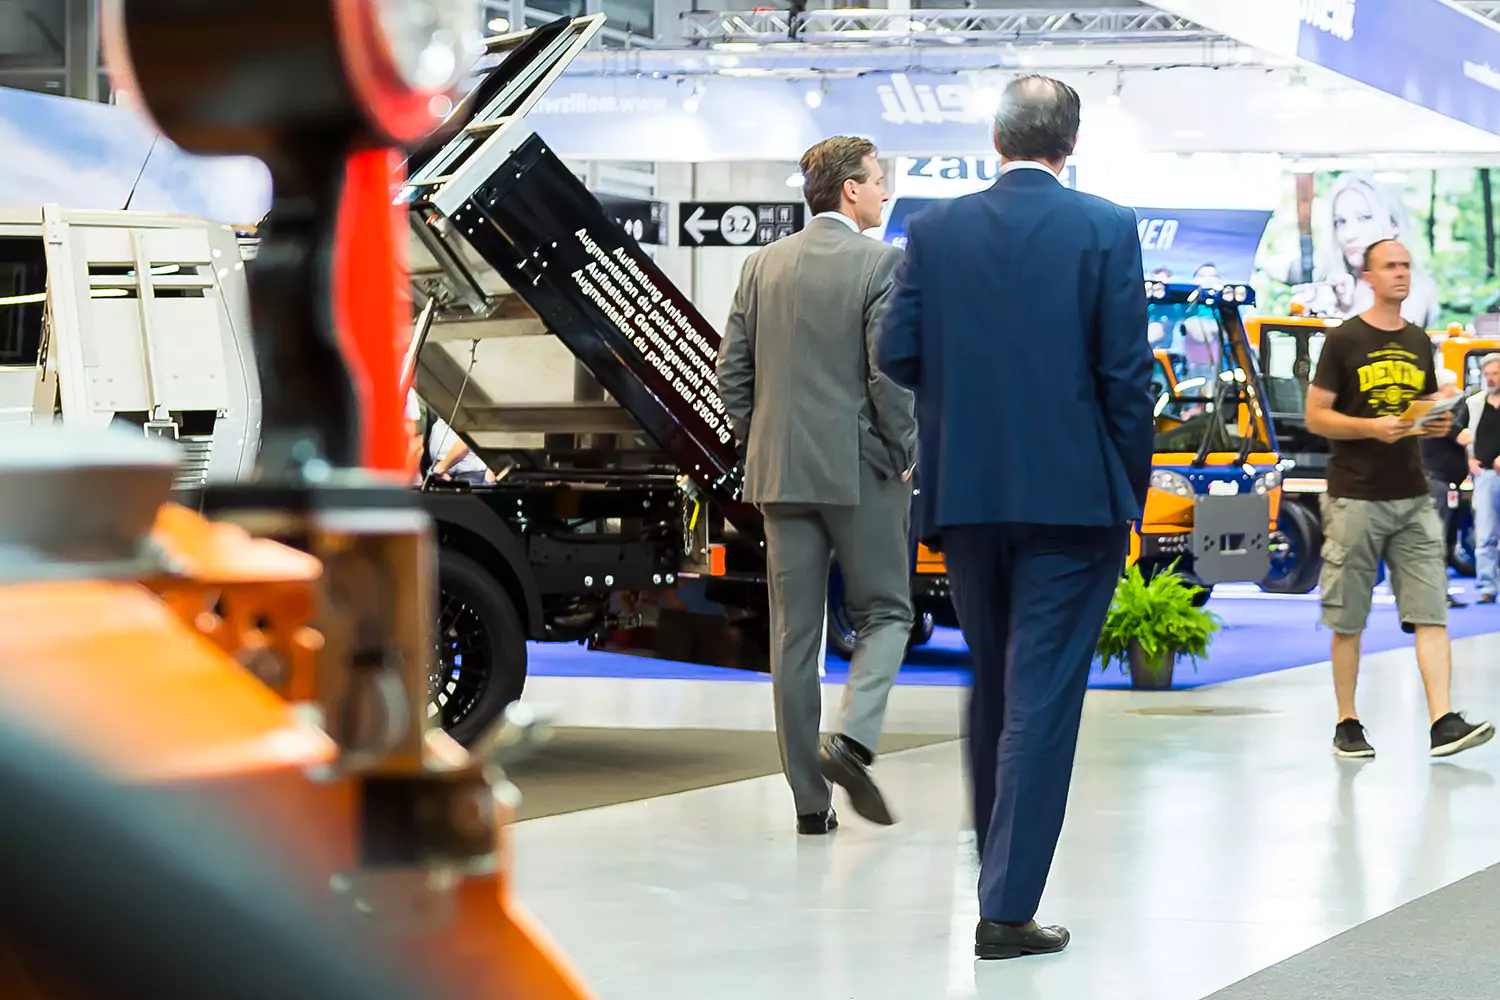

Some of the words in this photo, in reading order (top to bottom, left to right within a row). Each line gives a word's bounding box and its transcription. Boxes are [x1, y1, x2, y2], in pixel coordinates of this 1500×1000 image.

[612, 246, 663, 303] Auflastung
[727, 214, 751, 234] 3.2
[574, 227, 639, 298] Augmentation
[637, 295, 652, 313] du
[648, 309, 678, 341] poids
[584, 262, 636, 319] Auflastung
[634, 313, 703, 390] Gesamtgewicht
[571, 269, 636, 340] Augmentation
[633, 336, 649, 353] du
[644, 350, 674, 381] poids
[672, 377, 696, 403] total
[692, 399, 719, 429] 3'500
[716, 424, 731, 445] kg
